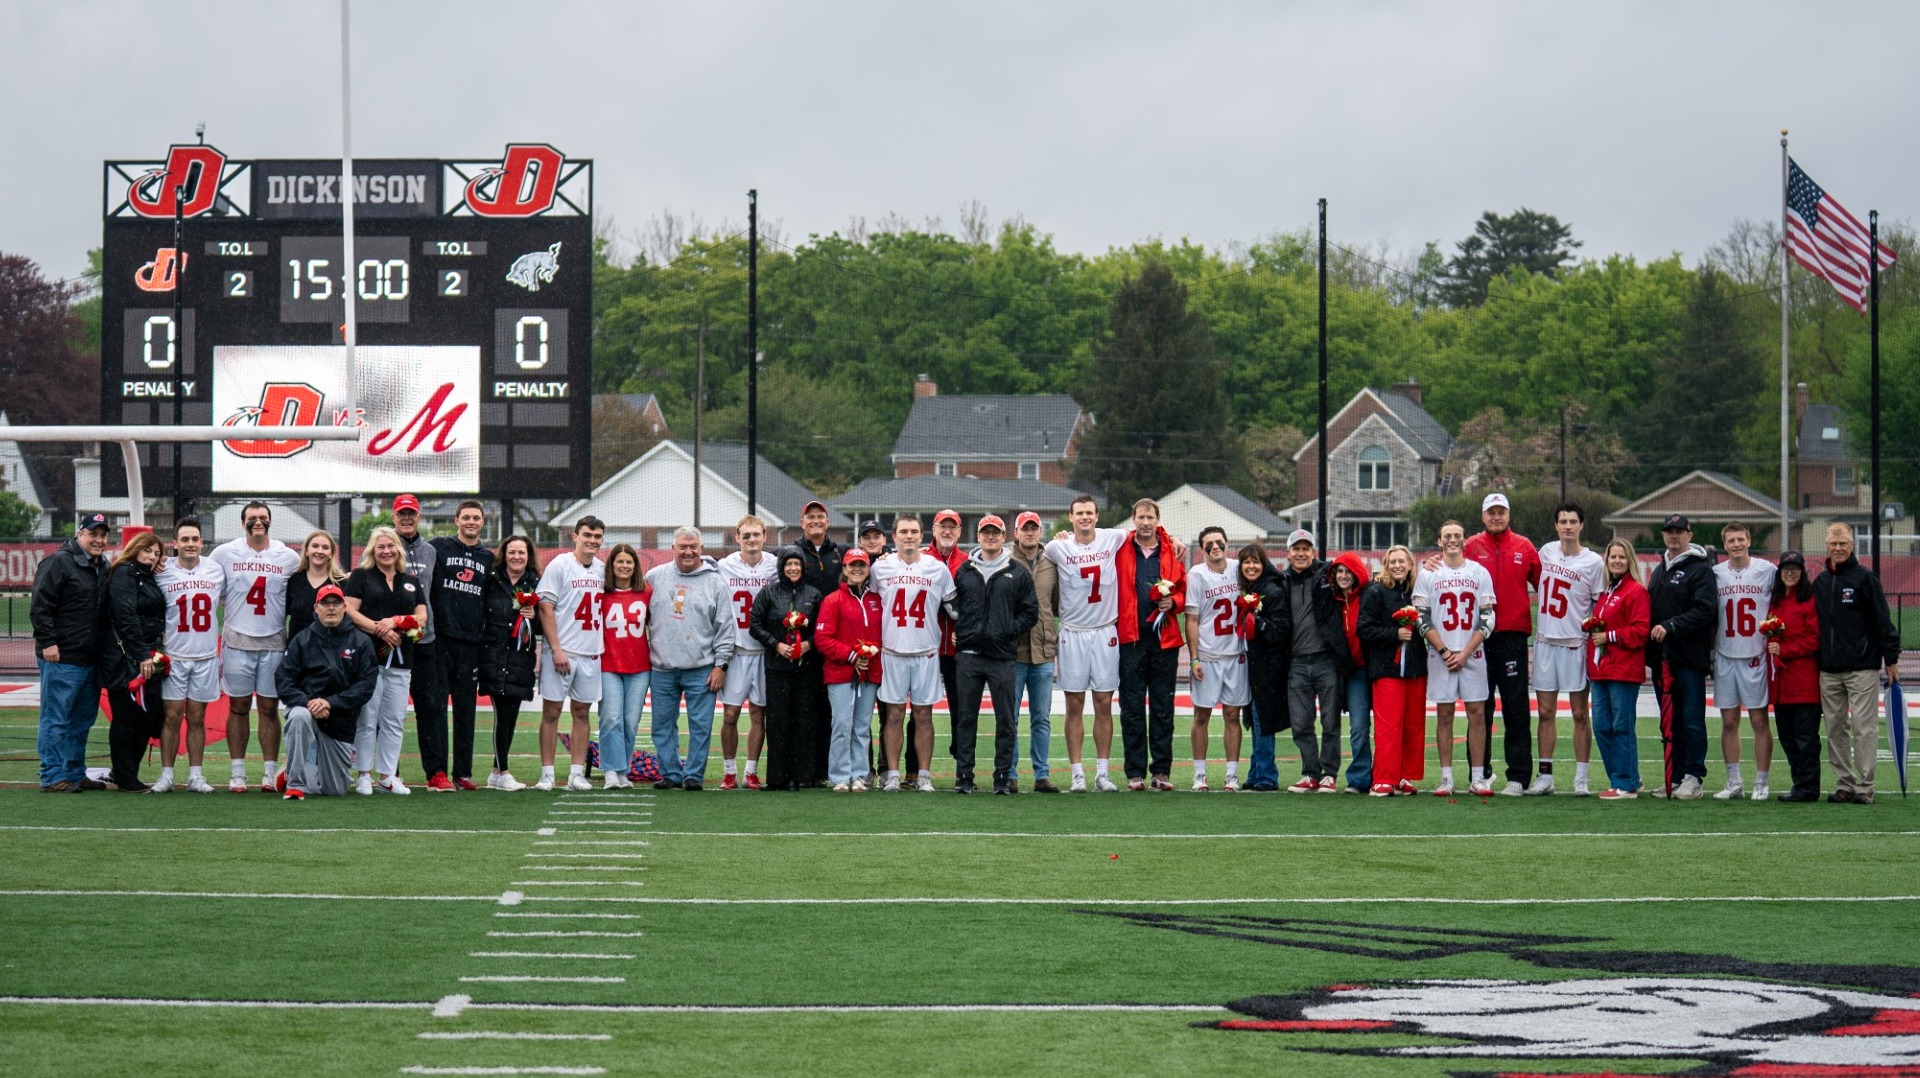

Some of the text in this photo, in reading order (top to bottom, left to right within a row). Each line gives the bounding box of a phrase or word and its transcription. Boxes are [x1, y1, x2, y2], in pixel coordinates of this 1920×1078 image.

[267, 175, 426, 204] DICKINSON
[230, 272, 247, 296] 2
[289, 259, 409, 300] 15:00
[444, 271, 461, 296] 2
[144, 315, 176, 369] 0
[515, 315, 549, 370] 0
[123, 381, 195, 397] PENALY
[494, 381, 569, 397] PENALTY
[232, 561, 283, 575] DICKINSON
[1066, 550, 1111, 565] DICKINSON
[571, 579, 605, 589] DICKINS
[729, 577, 776, 588] DICKINSO
[886, 575, 932, 588] DICKINSON
[1080, 565, 1102, 604] 7
[1542, 562, 1582, 583] DICKINSON
[167, 579, 216, 593] DICKINSON
[246, 575, 267, 616] 4
[443, 578, 482, 596] LACROSSE
[1204, 583, 1245, 599] DICKINSO
[1434, 579, 1479, 591] DICKINSON
[1716, 584, 1763, 597] DICKINSON
[891, 588, 928, 629] 44
[1541, 575, 1572, 620] 15
[176, 593, 212, 633] 18
[605, 600, 647, 639] 43
[1439, 591, 1476, 632] 33
[1725, 597, 1757, 638] 16
